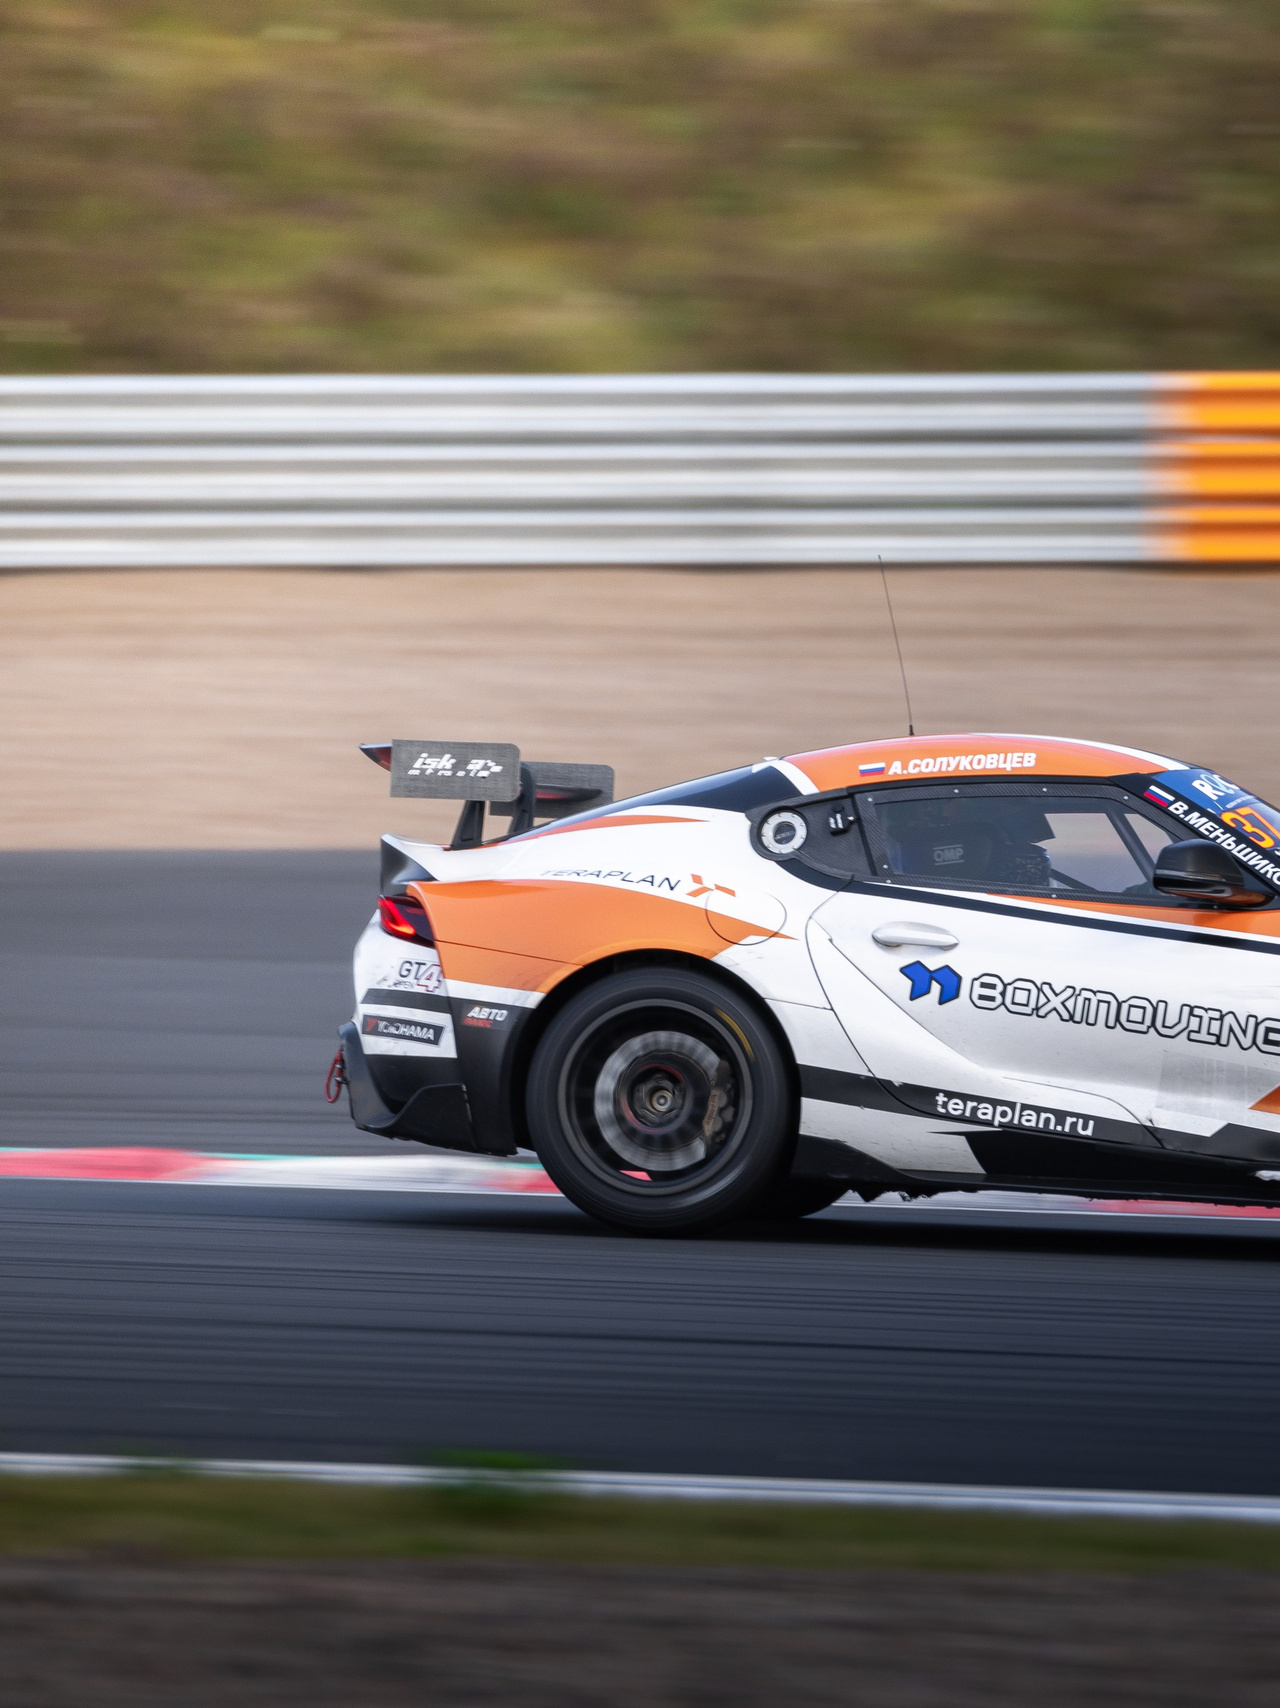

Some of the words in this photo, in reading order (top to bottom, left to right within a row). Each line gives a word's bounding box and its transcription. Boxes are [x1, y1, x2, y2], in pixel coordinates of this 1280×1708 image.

[888, 752, 1037, 775] А.СОЛУКОВЦЕВ
[540, 869, 682, 891] TERAPLAN
[399, 960, 443, 993] GT4
[466, 1006, 509, 1021] АВТО
[935, 1092, 1095, 1137] teraplan.ru
